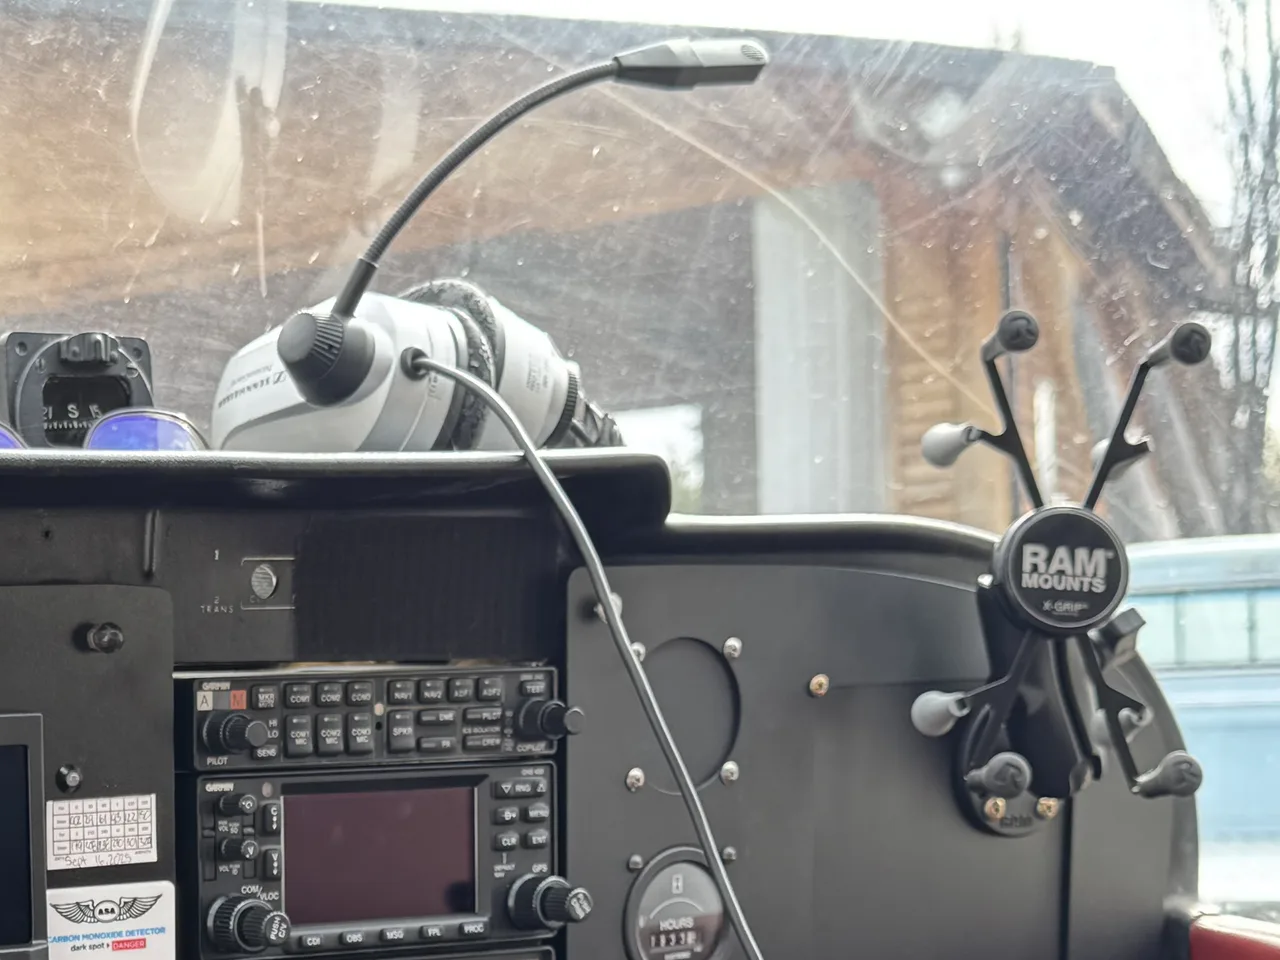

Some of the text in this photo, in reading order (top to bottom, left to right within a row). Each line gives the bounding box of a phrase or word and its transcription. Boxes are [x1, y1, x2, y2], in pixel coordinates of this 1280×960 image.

[67, 404, 79, 418] S
[89, 404, 102, 418] 15
[1021, 543, 1106, 578] RAM
[1021, 573, 1106, 593] MOUNTS
[202, 681, 231, 690] GARMIN
[526, 685, 545, 693] TEST
[394, 691, 412, 700] NAV1
[424, 690, 442, 699] NAV2
[454, 689, 472, 698] ADF1
[483, 688, 501, 697] ADF2
[290, 695, 310, 703] COM1
[321, 694, 341, 702] COM2
[482, 711, 501, 720] PILOT
[268, 730, 278, 738] LO
[392, 727, 413, 736] SPKR
[516, 743, 546, 752] COPILOT
[257, 749, 276, 758] SENS
[207, 757, 228, 766] PILOT
[205, 783, 234, 792] GARMIN
[515, 784, 531, 792] RNG
[501, 837, 517, 846] CLR
[532, 835, 546, 844] ENT
[532, 863, 548, 873] GPS
[98, 907, 116, 915] ASA
[660, 916, 694, 931] HOURS
[82, 930, 123, 940] MONOXIDE
[125, 926, 166, 937] DETECTOR
[464, 923, 484, 934] PROC
[346, 933, 363, 943] OBS
[386, 930, 404, 939] MSG
[70, 940, 145, 952] dark spot DANGER
